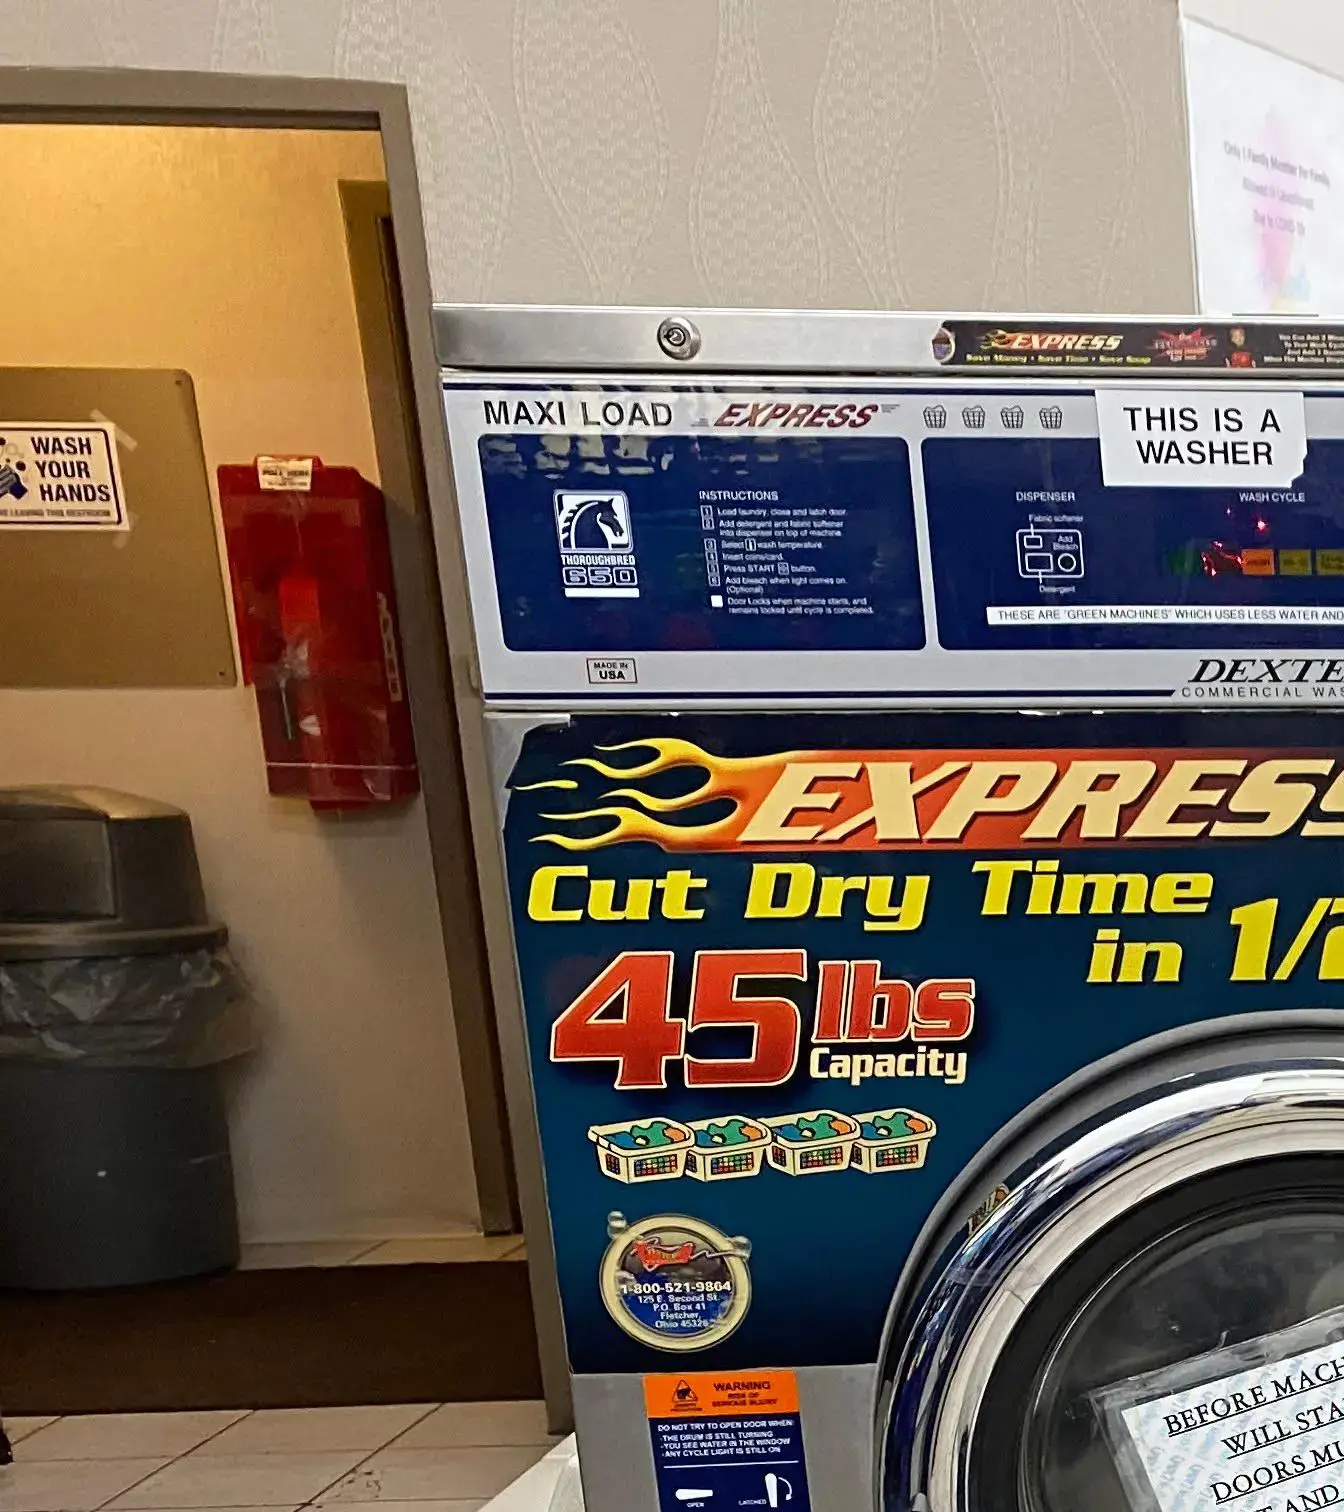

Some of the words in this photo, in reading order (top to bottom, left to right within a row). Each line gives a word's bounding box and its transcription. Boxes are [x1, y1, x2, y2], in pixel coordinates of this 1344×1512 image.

[483, 399, 567, 427] MAXI
[580, 401, 673, 427] LOAD
[714, 402, 880, 428] EXPRESS
[1122, 406, 1199, 432] THIS
[1214, 407, 1243, 433] IS
[1259, 408, 1281, 433] A
[31, 437, 92, 455] WASH
[1135, 439, 1273, 466] WASHER
[35, 460, 90, 478] YOUR
[39, 483, 111, 502] HANDS
[698, 490, 779, 501] INSTRUCTIONS
[1015, 491, 1076, 502] DISPENSER
[1239, 491, 1270, 503] WASH
[1271, 492, 1306, 503] CYCLE
[560, 554, 636, 566] THOROUGHBRED
[562, 566, 638, 586] 650
[598, 670, 626, 681] USA
[1181, 686, 1303, 698] COMMERCIAL
[527, 864, 708, 922] Cut
[744, 861, 931, 932] Dry
[972, 860, 1214, 916] Time
[1086, 928, 1183, 983] in
[549, 949, 807, 1090] 45
[810, 959, 976, 1043] lbs
[809, 1046, 968, 1085] Capacity
[1162, 1385, 1268, 1436] BEFORE
[1222, 1419, 1292, 1457] WILL
[1209, 1455, 1306, 1503] DOORS
